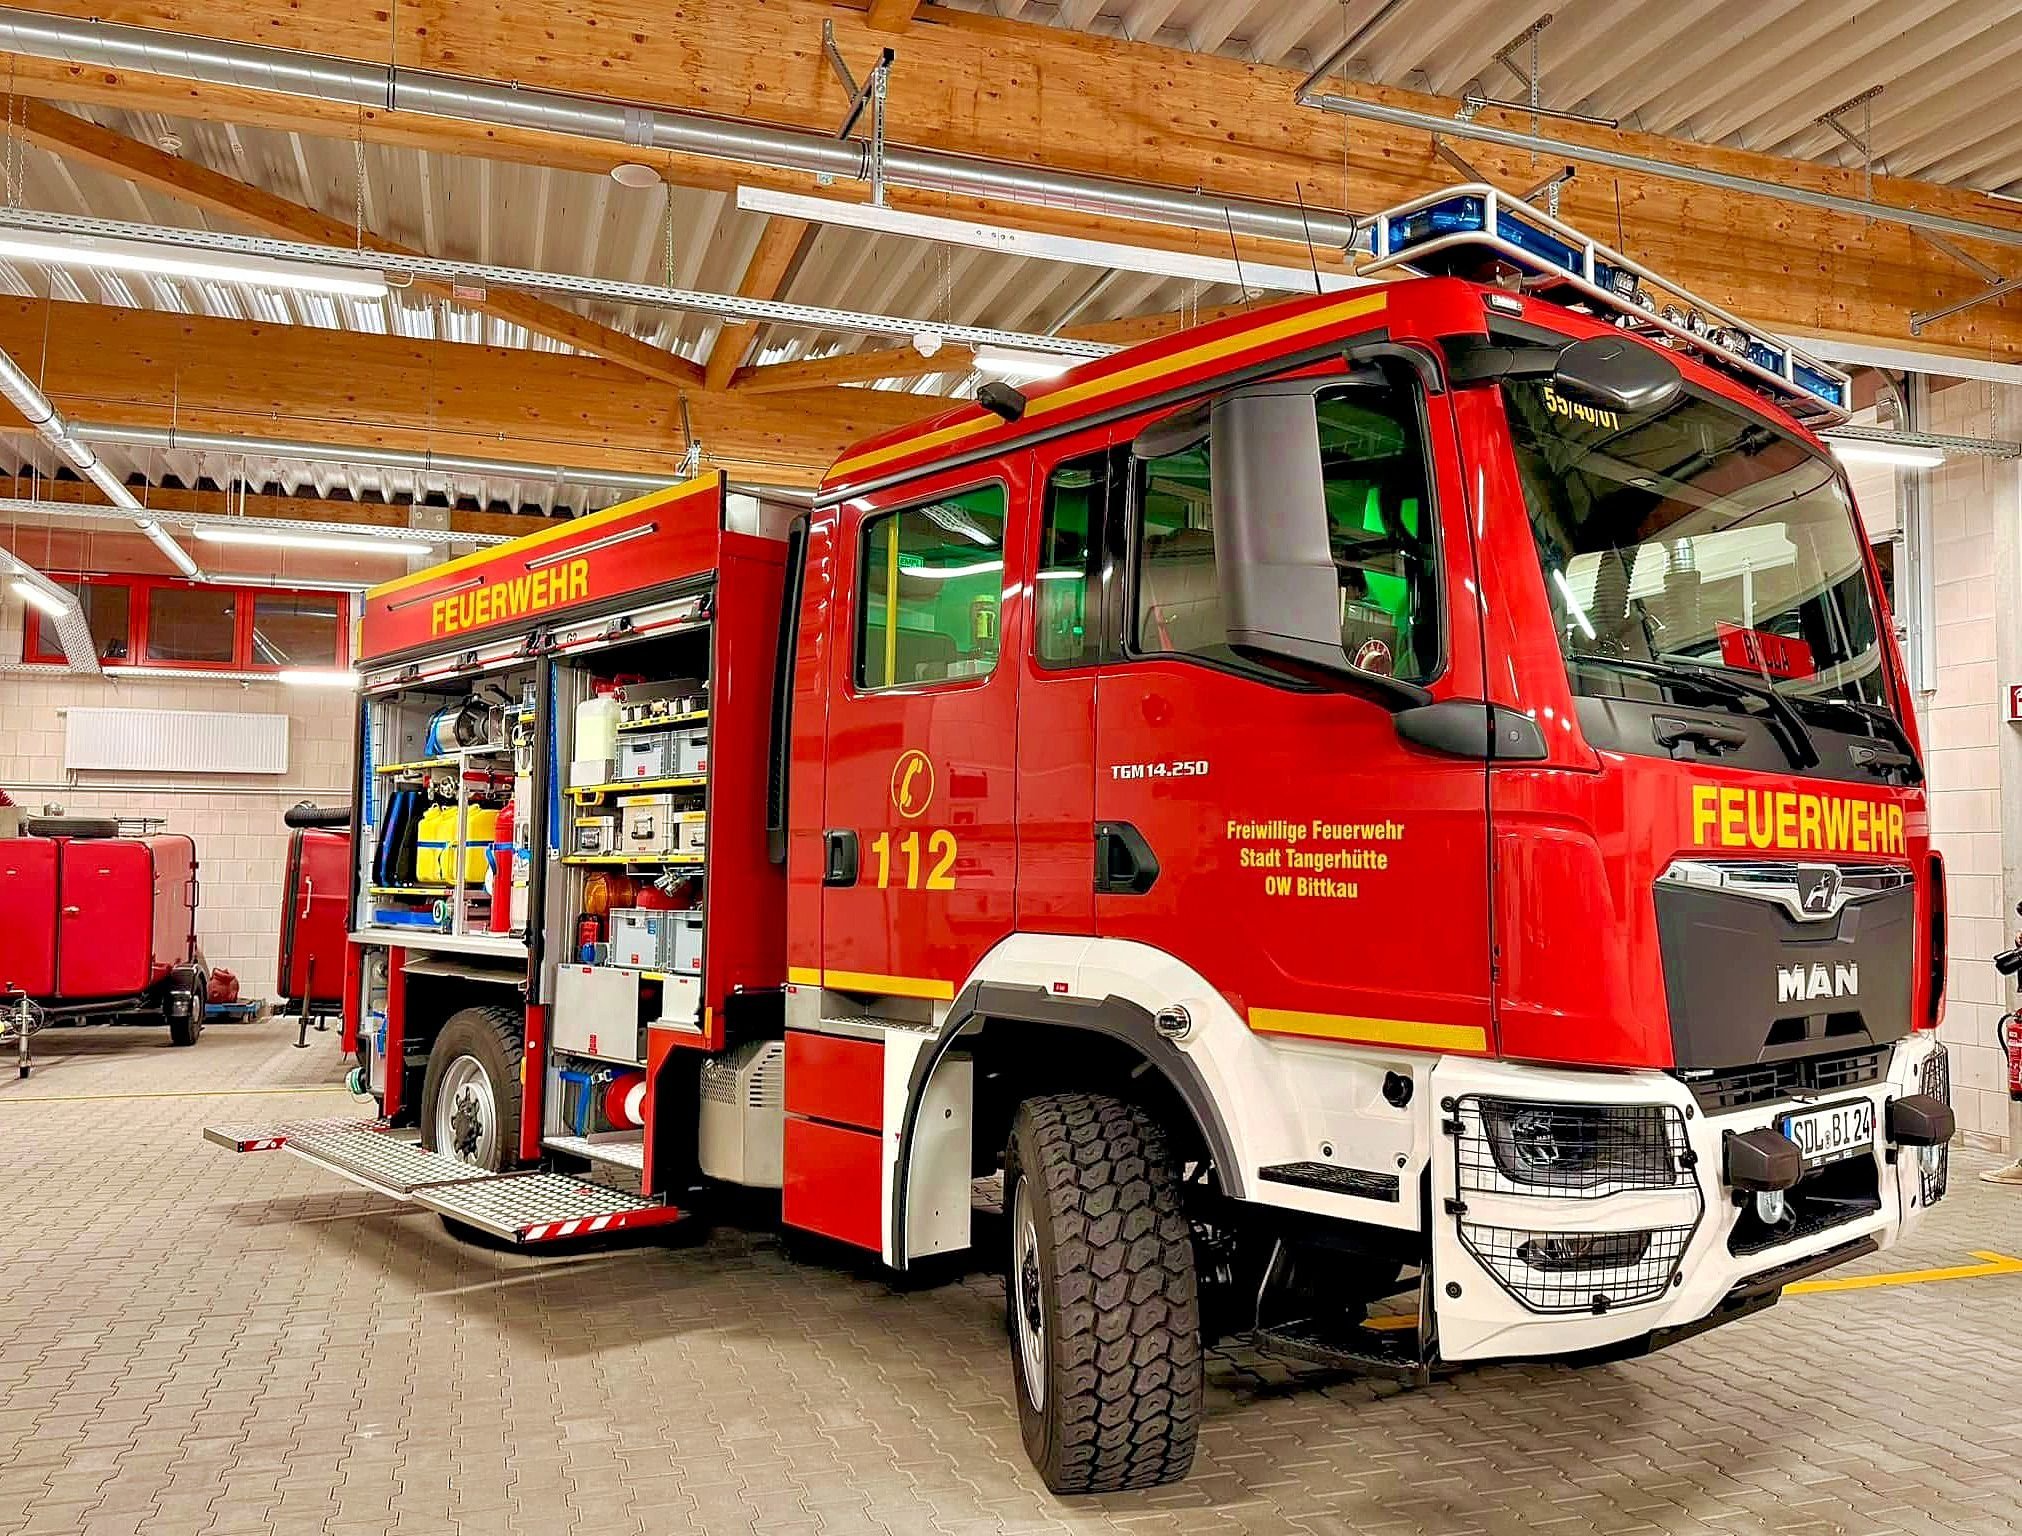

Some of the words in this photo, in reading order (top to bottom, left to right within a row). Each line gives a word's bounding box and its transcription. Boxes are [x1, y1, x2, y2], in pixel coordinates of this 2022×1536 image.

[432, 559, 589, 636] FEUERWEHR
[1111, 764, 1144, 779] TGM
[1147, 761, 1209, 777] 14.250
[1227, 820, 1307, 843] Freiwillige
[1312, 820, 1405, 840] Feuerwehr
[1692, 785, 1905, 854] FEUERWEHR
[872, 829, 957, 889] 112
[1240, 848, 1281, 868] Stadt
[1286, 849, 1388, 872] Tangerhütte
[1265, 876, 1292, 896] OW
[1297, 877, 1358, 898] Bittkau
[1776, 961, 1859, 1002] MAN
[1794, 1118, 1824, 1154] SDL
[1832, 1113, 1850, 1147] BI
[1854, 1106, 1870, 1142] 24
